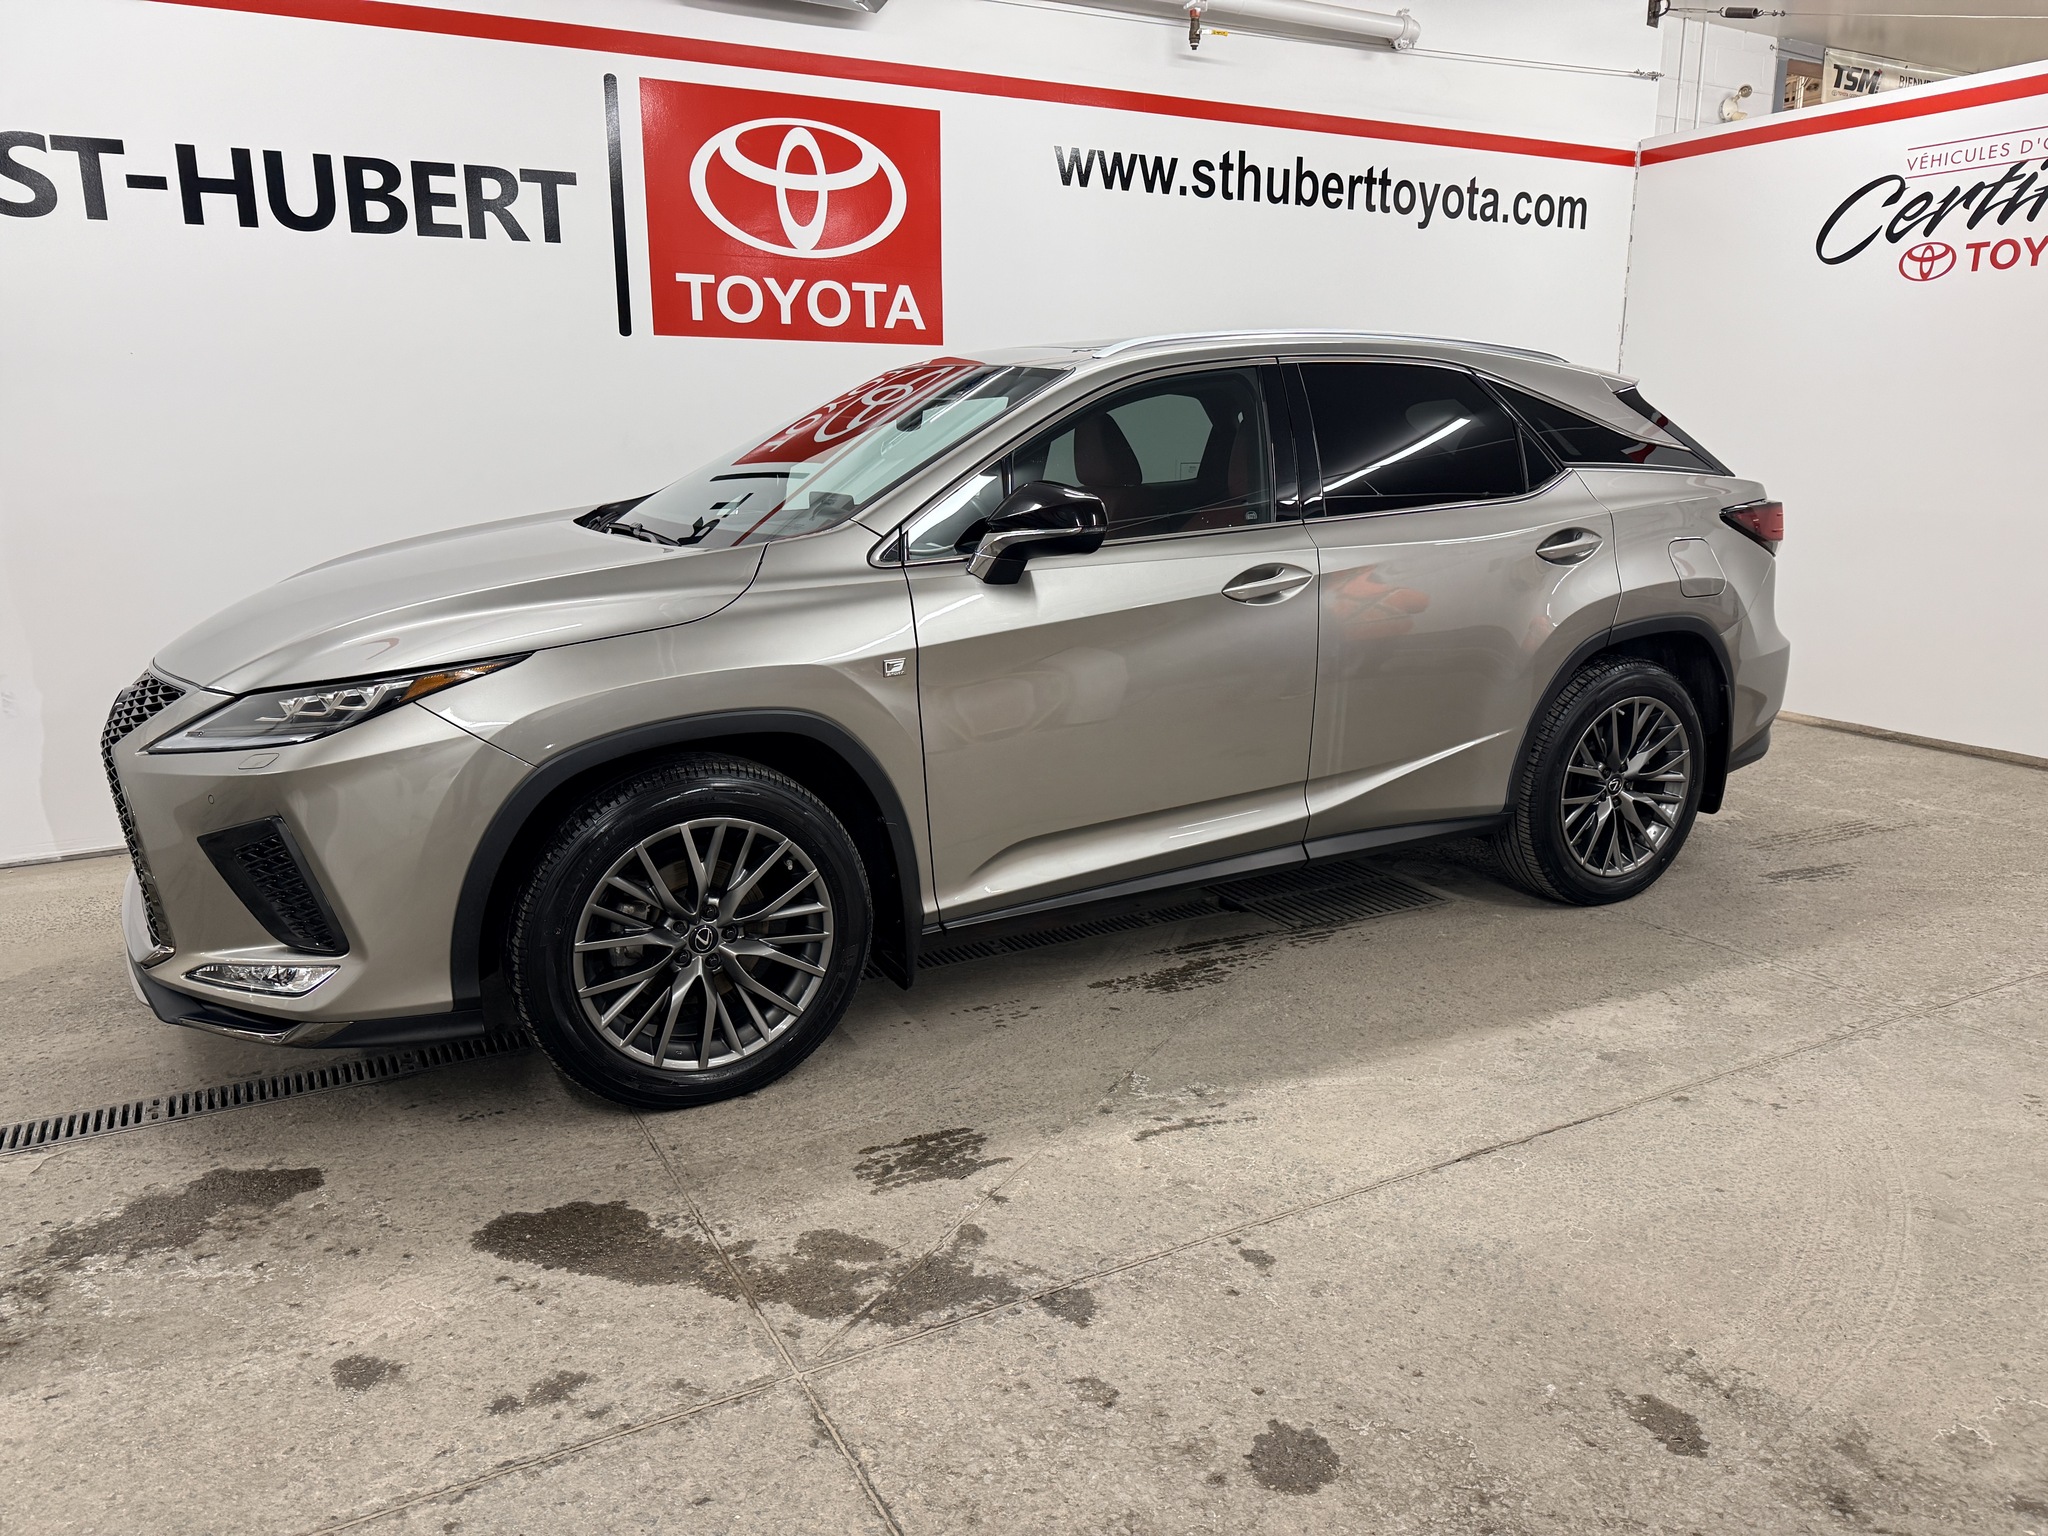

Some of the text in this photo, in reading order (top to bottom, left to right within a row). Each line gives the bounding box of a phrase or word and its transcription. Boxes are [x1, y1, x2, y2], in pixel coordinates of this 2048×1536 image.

[1834, 64, 1880, 94] TSM
[1906, 142, 2010, 171] VÉHICULES
[0, 130, 577, 244] ST-HUBERT
[1053, 145, 1588, 230] www.sthuberttoyota.com
[675, 272, 926, 330] TOYOTA
